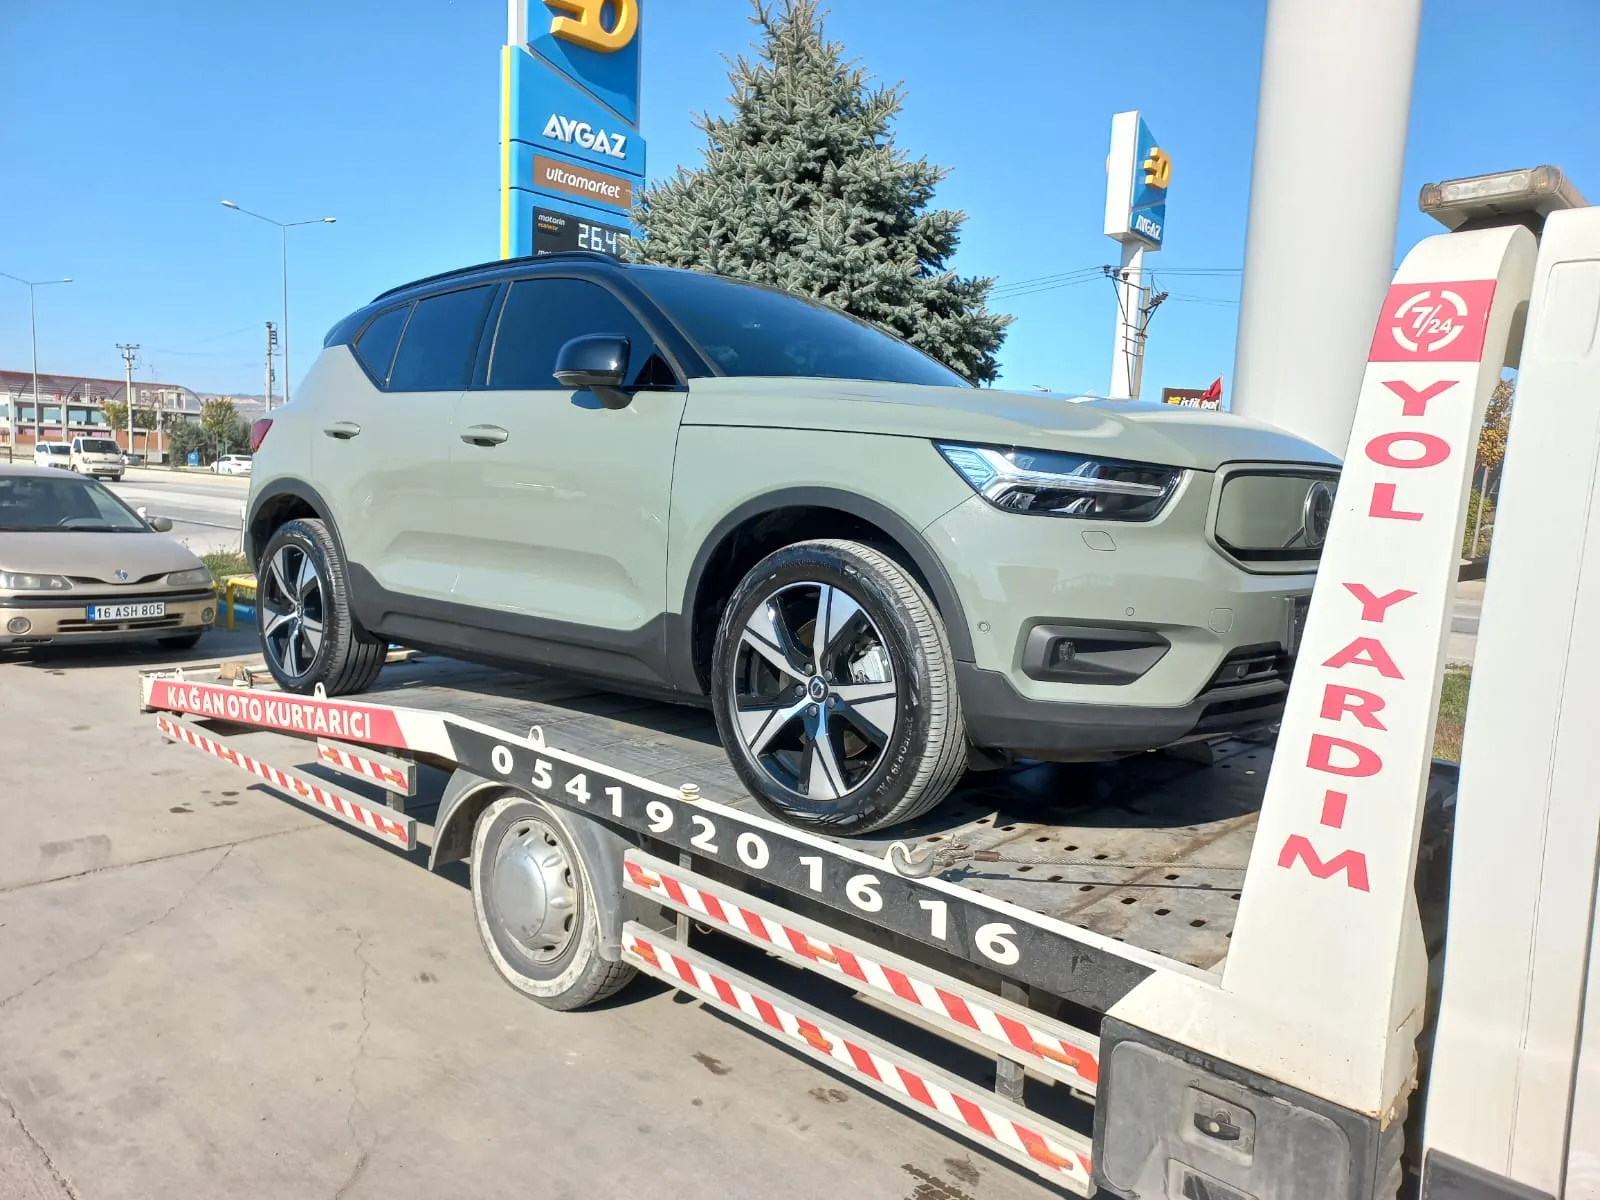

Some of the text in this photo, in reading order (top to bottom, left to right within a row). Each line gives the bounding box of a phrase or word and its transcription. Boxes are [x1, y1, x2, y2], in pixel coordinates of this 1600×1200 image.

[542, 113, 626, 159] AYGAZ
[546, 167, 621, 198] ultramarket
[538, 213, 566, 228] motorin
[1135, 214, 1162, 240] AYGAZ
[1411, 304, 1453, 338] 7/24
[97, 607, 111, 618] 16
[115, 606, 138, 617] ASH
[141, 603, 163, 615] 805
[1277, 379, 1461, 893] YOL YARDIM
[167, 685, 371, 739] KAĞAN OTO KURTARICI
